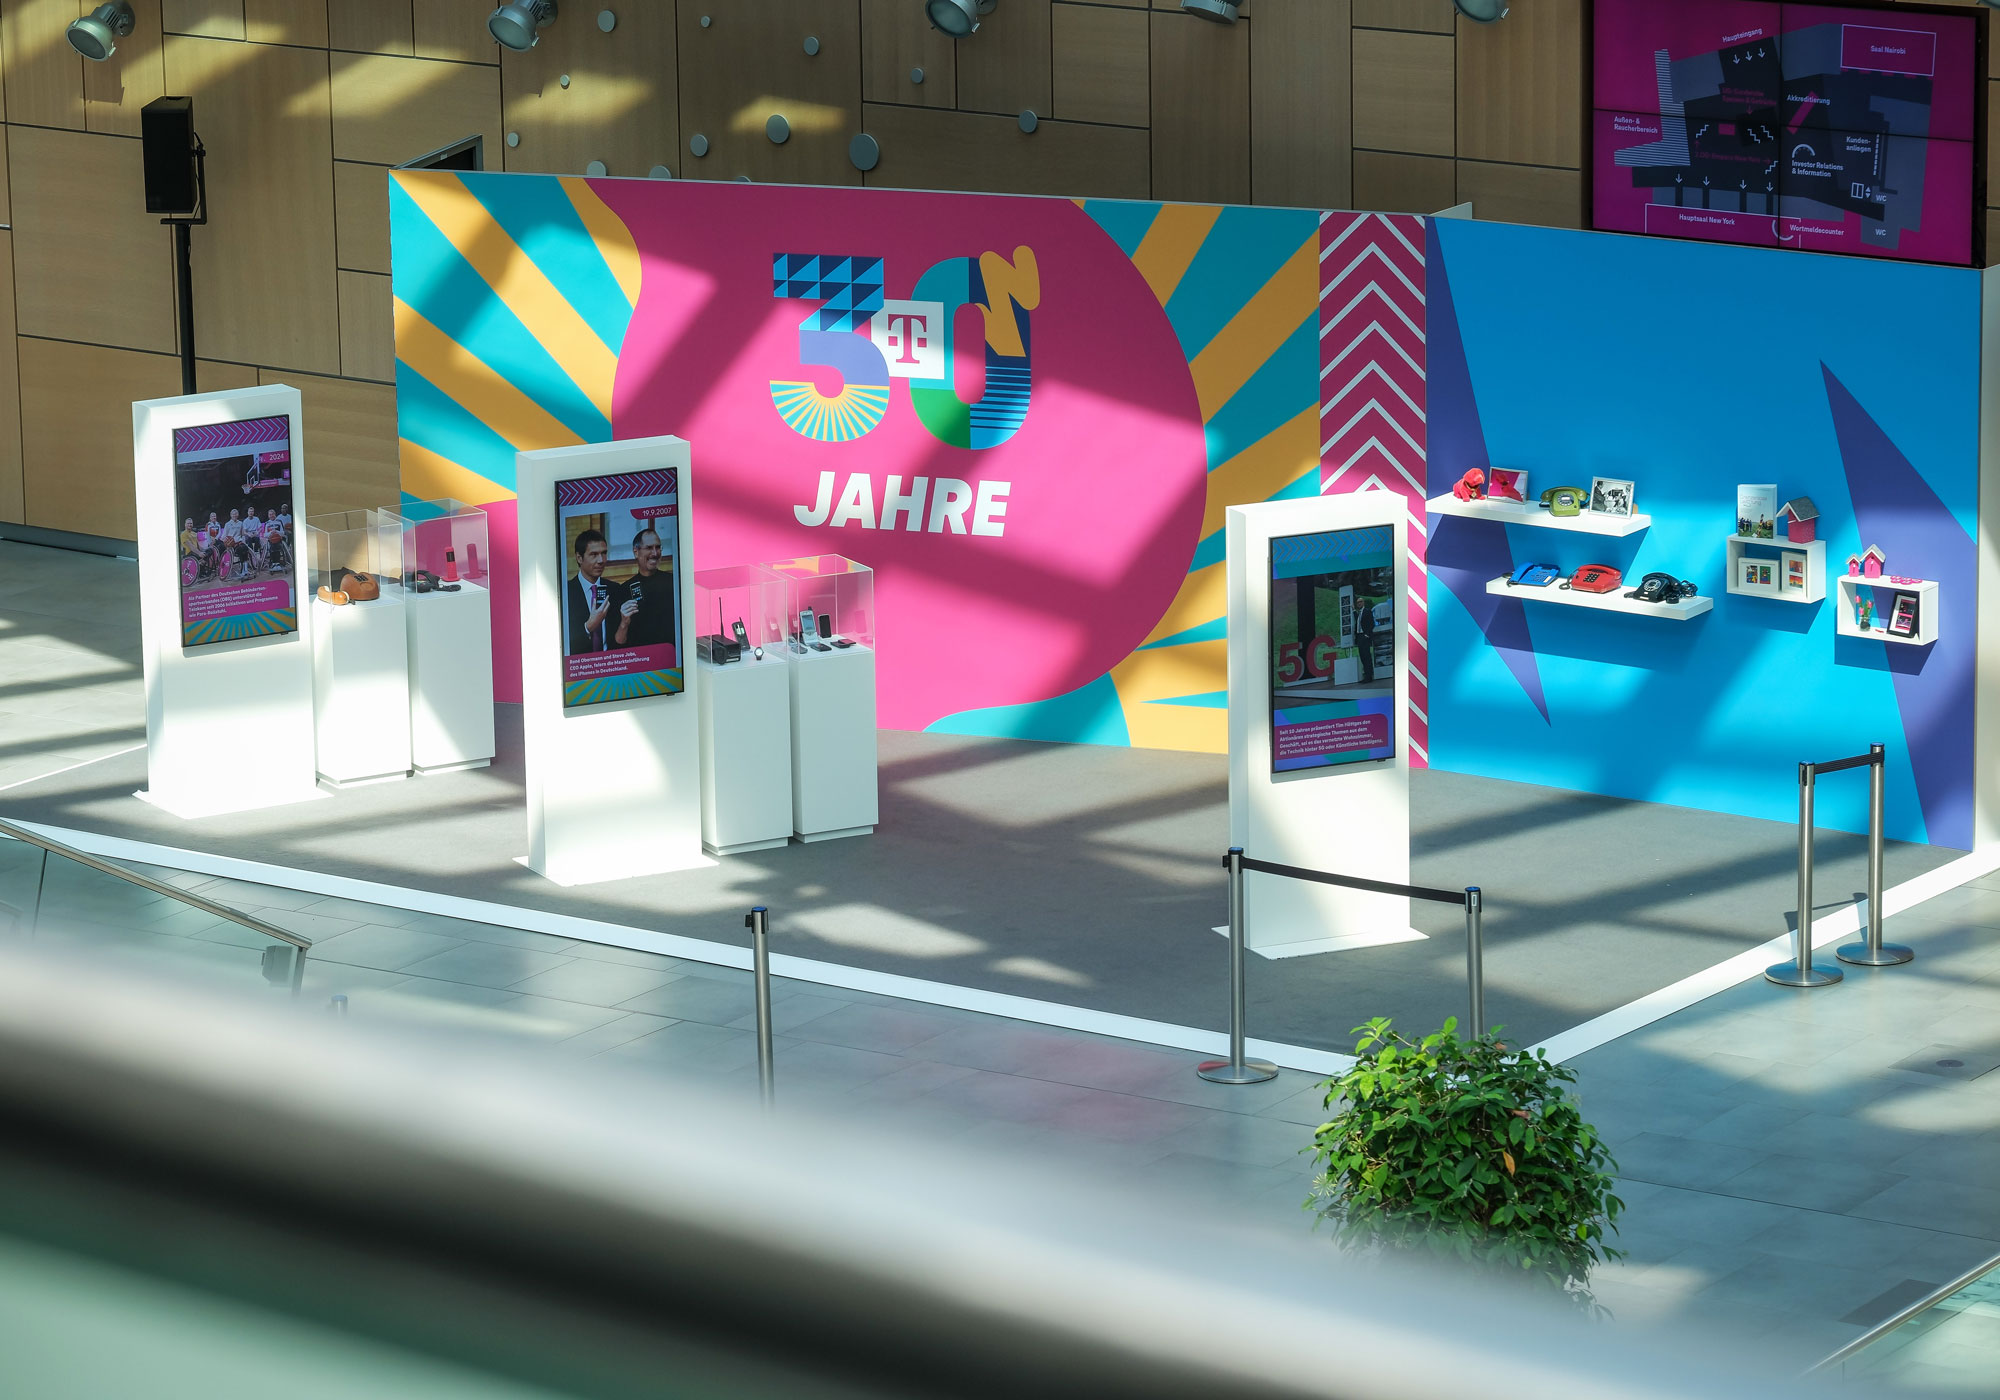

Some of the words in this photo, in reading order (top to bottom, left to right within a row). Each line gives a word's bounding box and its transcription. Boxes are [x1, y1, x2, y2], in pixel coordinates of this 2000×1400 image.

[1722, 28, 1762, 42] Haupteingang
[1884, 46, 1906, 54] Nairobi
[1787, 94, 1830, 105] Akkreditierung
[1614, 116, 1634, 124] Außen-
[1614, 123, 1658, 134] Raucherbereich
[1846, 136, 1871, 144] Kunden-
[1846, 145, 1871, 153] anliegen
[1816, 162, 1843, 170] Relations
[1797, 169, 1831, 177] Information
[1679, 214, 1708, 223] Hauptsaal
[1790, 224, 1844, 236] Wortmeldecounter
[769, 246, 1038, 450] 30
[794, 470, 1011, 536] JAHRE
[642, 507, 672, 516] 19.9.2007
[614, 657, 650, 665] Markteinführung
[1278, 635, 1338, 683] 5G
[1311, 724, 1335, 732] präsentiert
[1304, 731, 1331, 740] strategische
